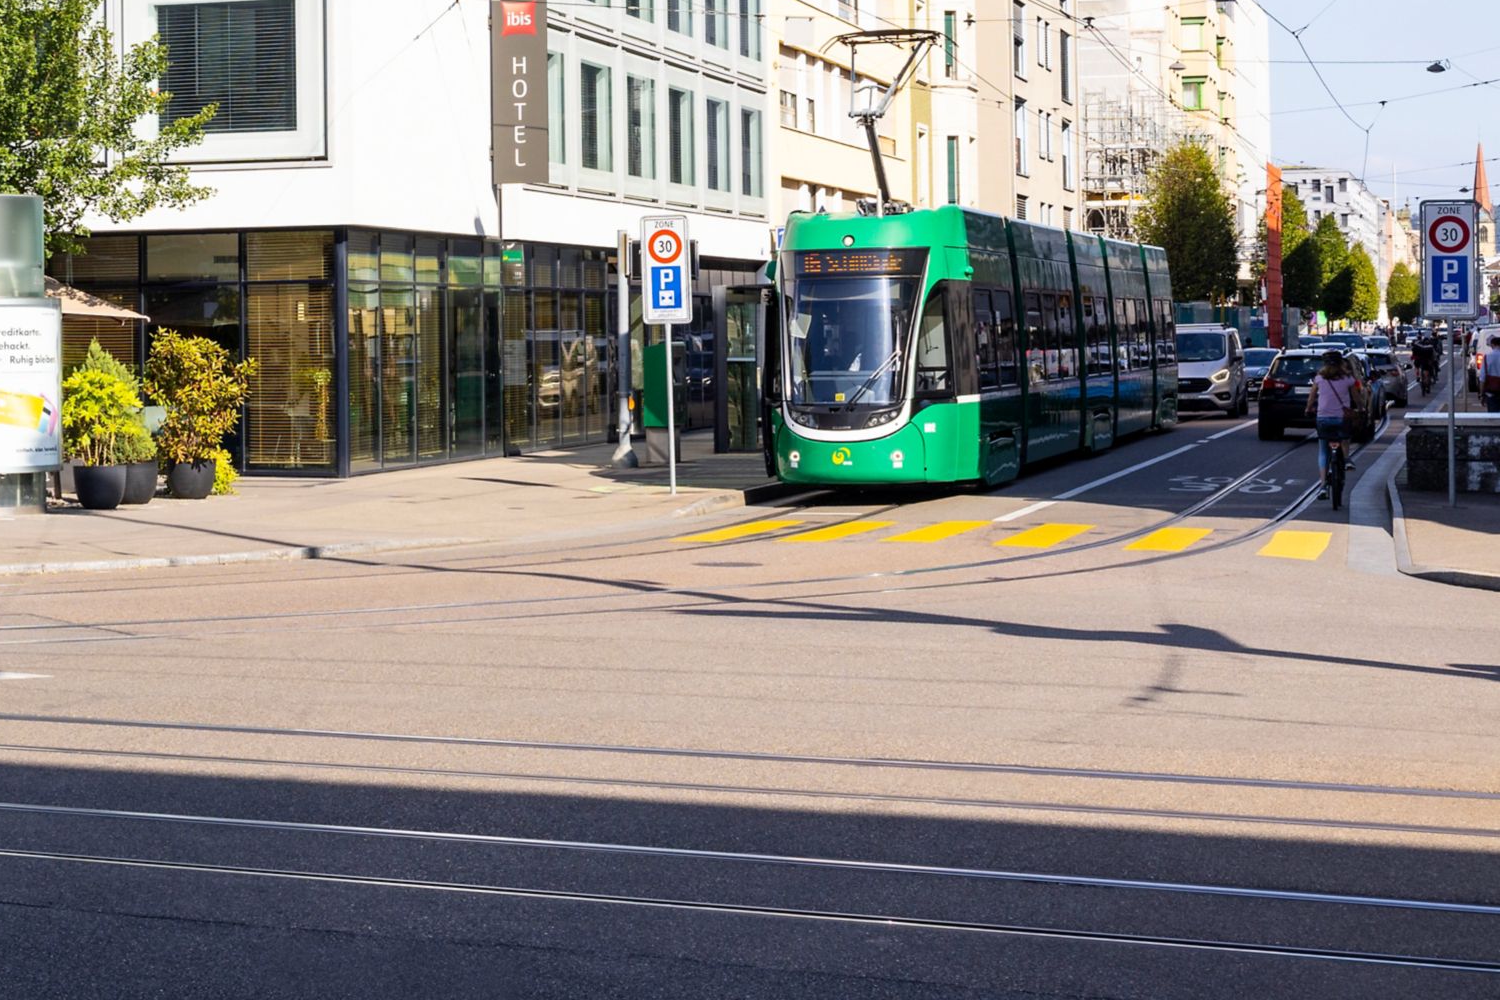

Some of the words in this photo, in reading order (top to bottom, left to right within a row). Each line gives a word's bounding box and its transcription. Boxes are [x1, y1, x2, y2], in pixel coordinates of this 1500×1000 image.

[506, 11, 532, 26] ibis
[512, 56, 528, 168] HOTEL
[1437, 206, 1461, 215] ZONE
[654, 220, 674, 229] ZONE
[1441, 227, 1458, 242] 30
[658, 240, 672, 253] 30
[1443, 259, 1459, 282] P
[660, 268, 674, 290] P
[9, 355, 34, 366] Ruhig
